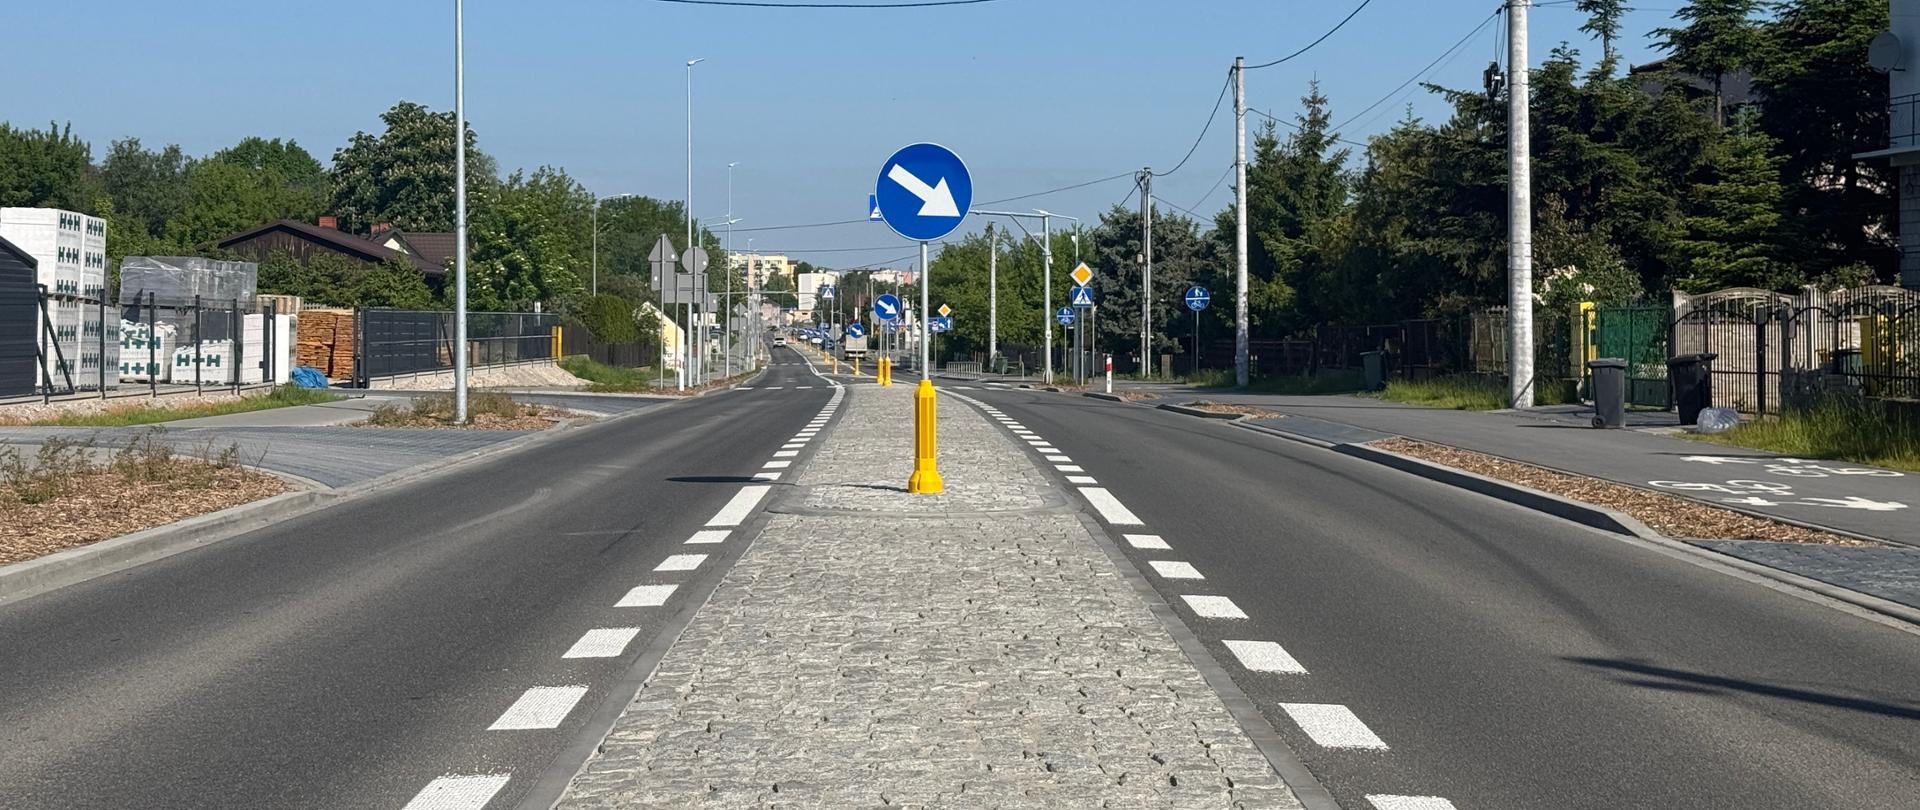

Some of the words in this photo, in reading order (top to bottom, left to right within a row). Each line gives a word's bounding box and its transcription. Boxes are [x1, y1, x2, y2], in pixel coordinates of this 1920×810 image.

[60, 213, 80, 231] H+H
[87, 219, 104, 237] H+H
[58, 246, 79, 264] H+H
[85, 252, 103, 269] H+H
[57, 279, 78, 294] H+H
[58, 325, 77, 341] H+H
[82, 353, 99, 368] H+H
